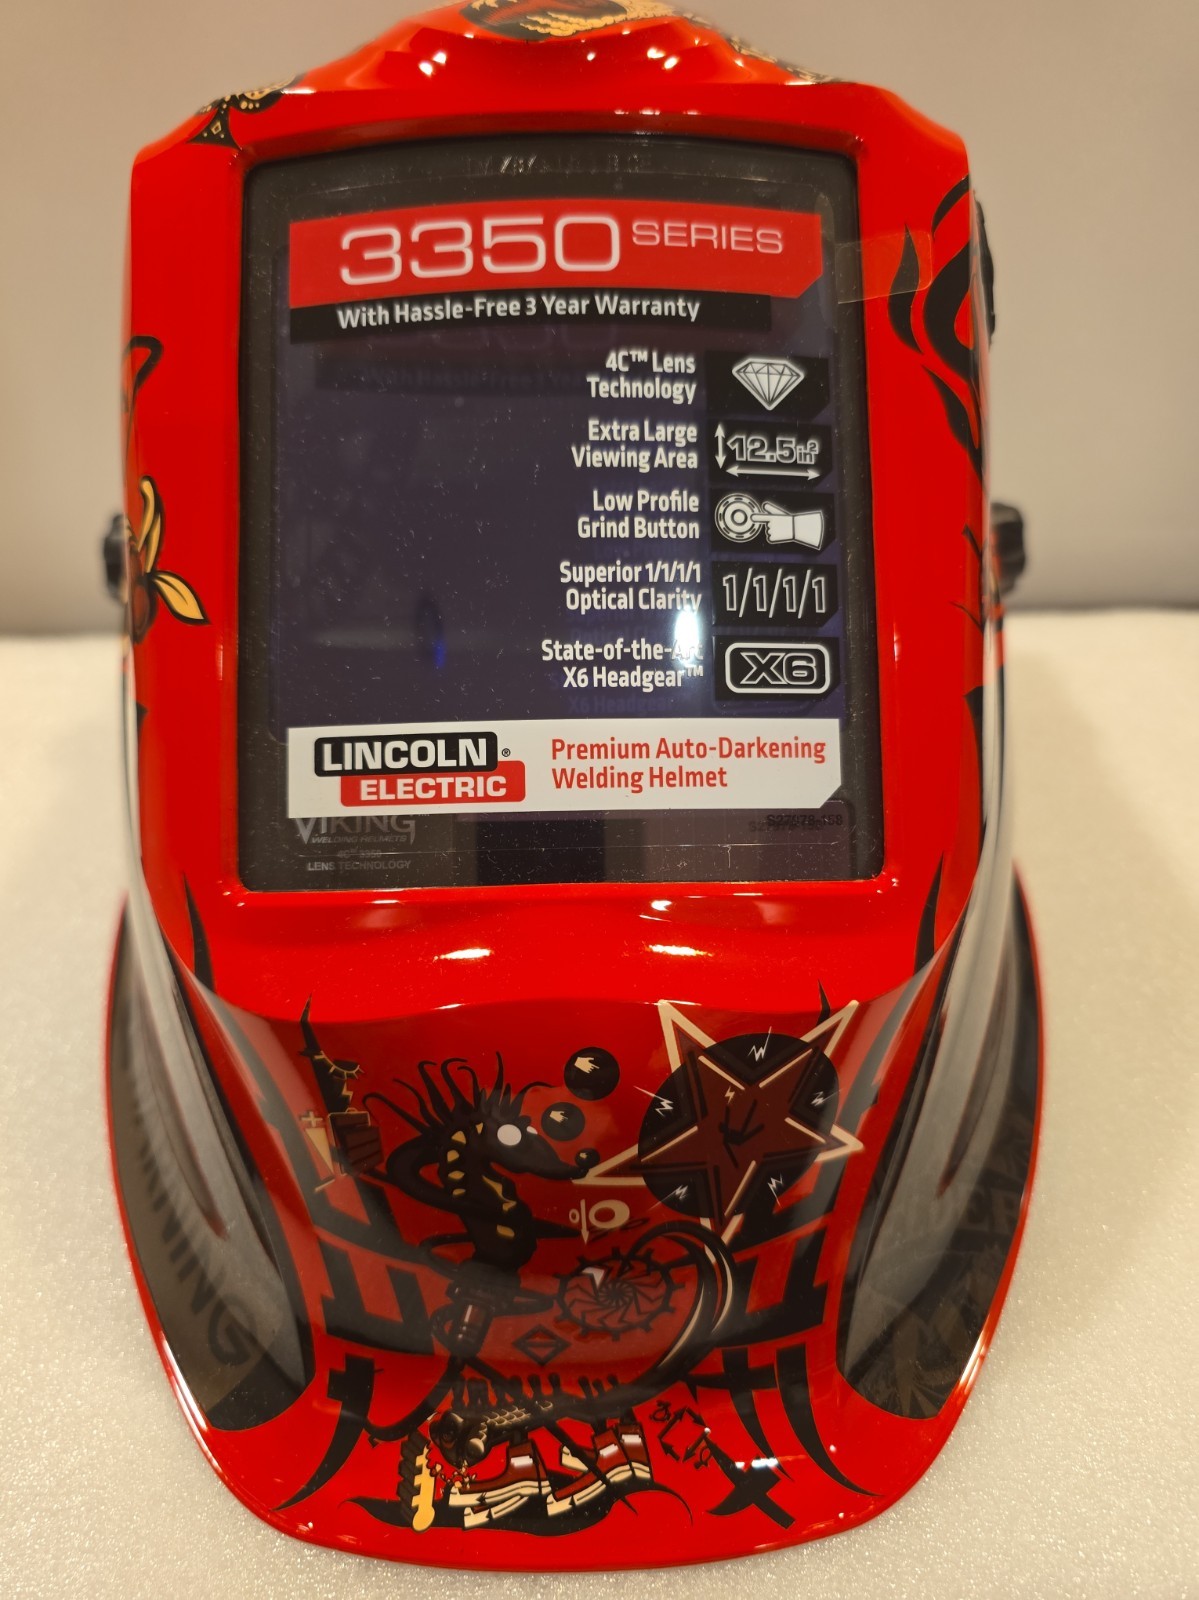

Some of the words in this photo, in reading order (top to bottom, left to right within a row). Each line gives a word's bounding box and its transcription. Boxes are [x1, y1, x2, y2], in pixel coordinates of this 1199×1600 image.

[340, 216, 620, 285] 3350
[632, 221, 783, 254] SERIES
[337, 305, 389, 329] With
[395, 298, 520, 323] Hassle-Free
[526, 297, 537, 315] 3
[541, 295, 590, 315] Year
[594, 295, 700, 322] Warranty
[652, 352, 696, 374] Lens
[586, 376, 697, 405] Technology
[588, 419, 640, 441] Extra
[644, 420, 698, 447] Large
[571, 446, 650, 473] Viewing
[653, 447, 698, 469] Area
[593, 489, 633, 512] Low
[637, 490, 700, 513] Profile
[577, 517, 630, 539] Grind
[634, 517, 700, 539] Button
[560, 560, 642, 587] Superior
[645, 560, 701, 583] 1/1/1/1
[565, 588, 634, 614] Optical
[638, 588, 703, 613] Clarity
[722, 568, 826, 619] 1/1/1/1
[563, 666, 589, 688] X6
[740, 652, 818, 685] X6
[323, 738, 487, 771] LINCOLN
[551, 736, 650, 760] Premium
[655, 735, 826, 764] Auto-Darkening
[360, 775, 507, 801] ELECTRIC
[552, 765, 644, 793] Welding
[649, 765, 728, 788] Helmet
[311, 835, 358, 844] WELDING
[360, 834, 408, 844] HELMETS
[307, 861, 336, 871] LENS
[339, 860, 412, 870] TECHNOLOGY
